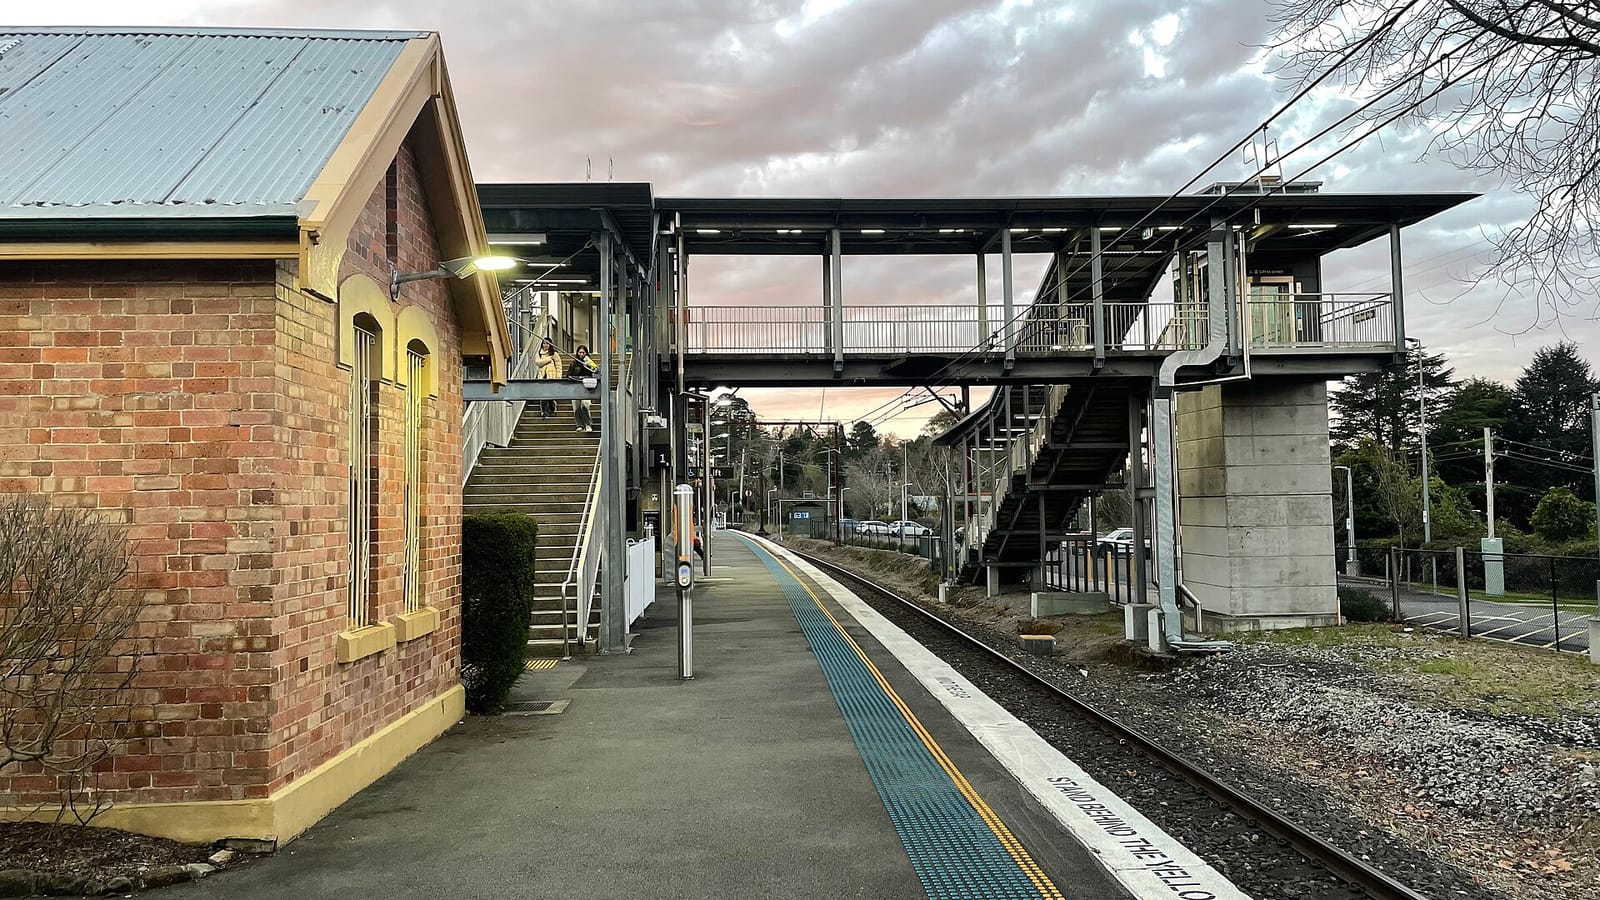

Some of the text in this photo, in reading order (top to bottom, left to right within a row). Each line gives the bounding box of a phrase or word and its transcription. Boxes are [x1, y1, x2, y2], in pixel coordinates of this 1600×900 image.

[1046, 776, 1217, 900] STAND BEHIND THE YELLO
